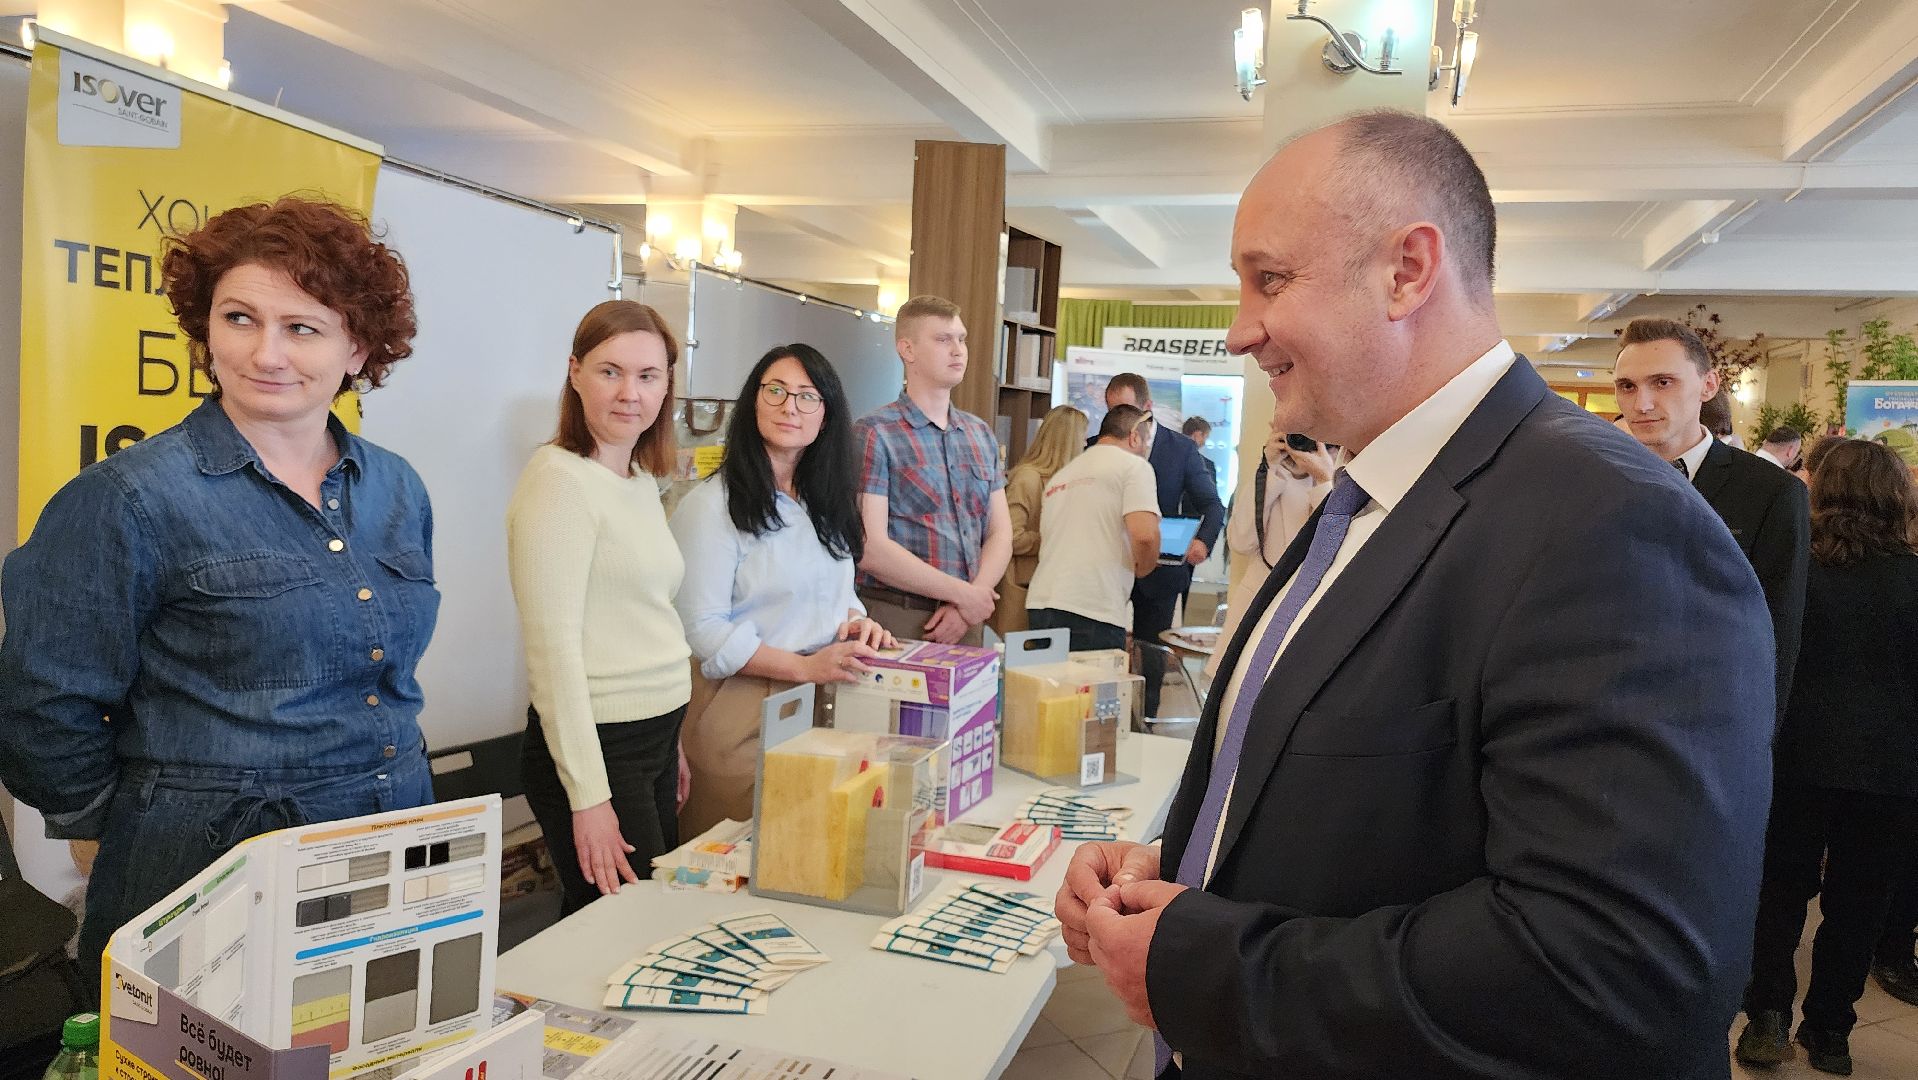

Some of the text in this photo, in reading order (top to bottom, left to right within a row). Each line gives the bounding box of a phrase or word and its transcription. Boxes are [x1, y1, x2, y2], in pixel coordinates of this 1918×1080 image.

[54, 238, 166, 296] ТЕП
[138, 329, 214, 398] БЕ
[1123, 337, 1229, 357] BRASBER
[80, 424, 146, 473] IS
[121, 979, 153, 1008] vetonit
[115, 1049, 136, 1070] Сухие
[180, 1012, 205, 1044] Всё
[208, 1029, 252, 1072] будет
